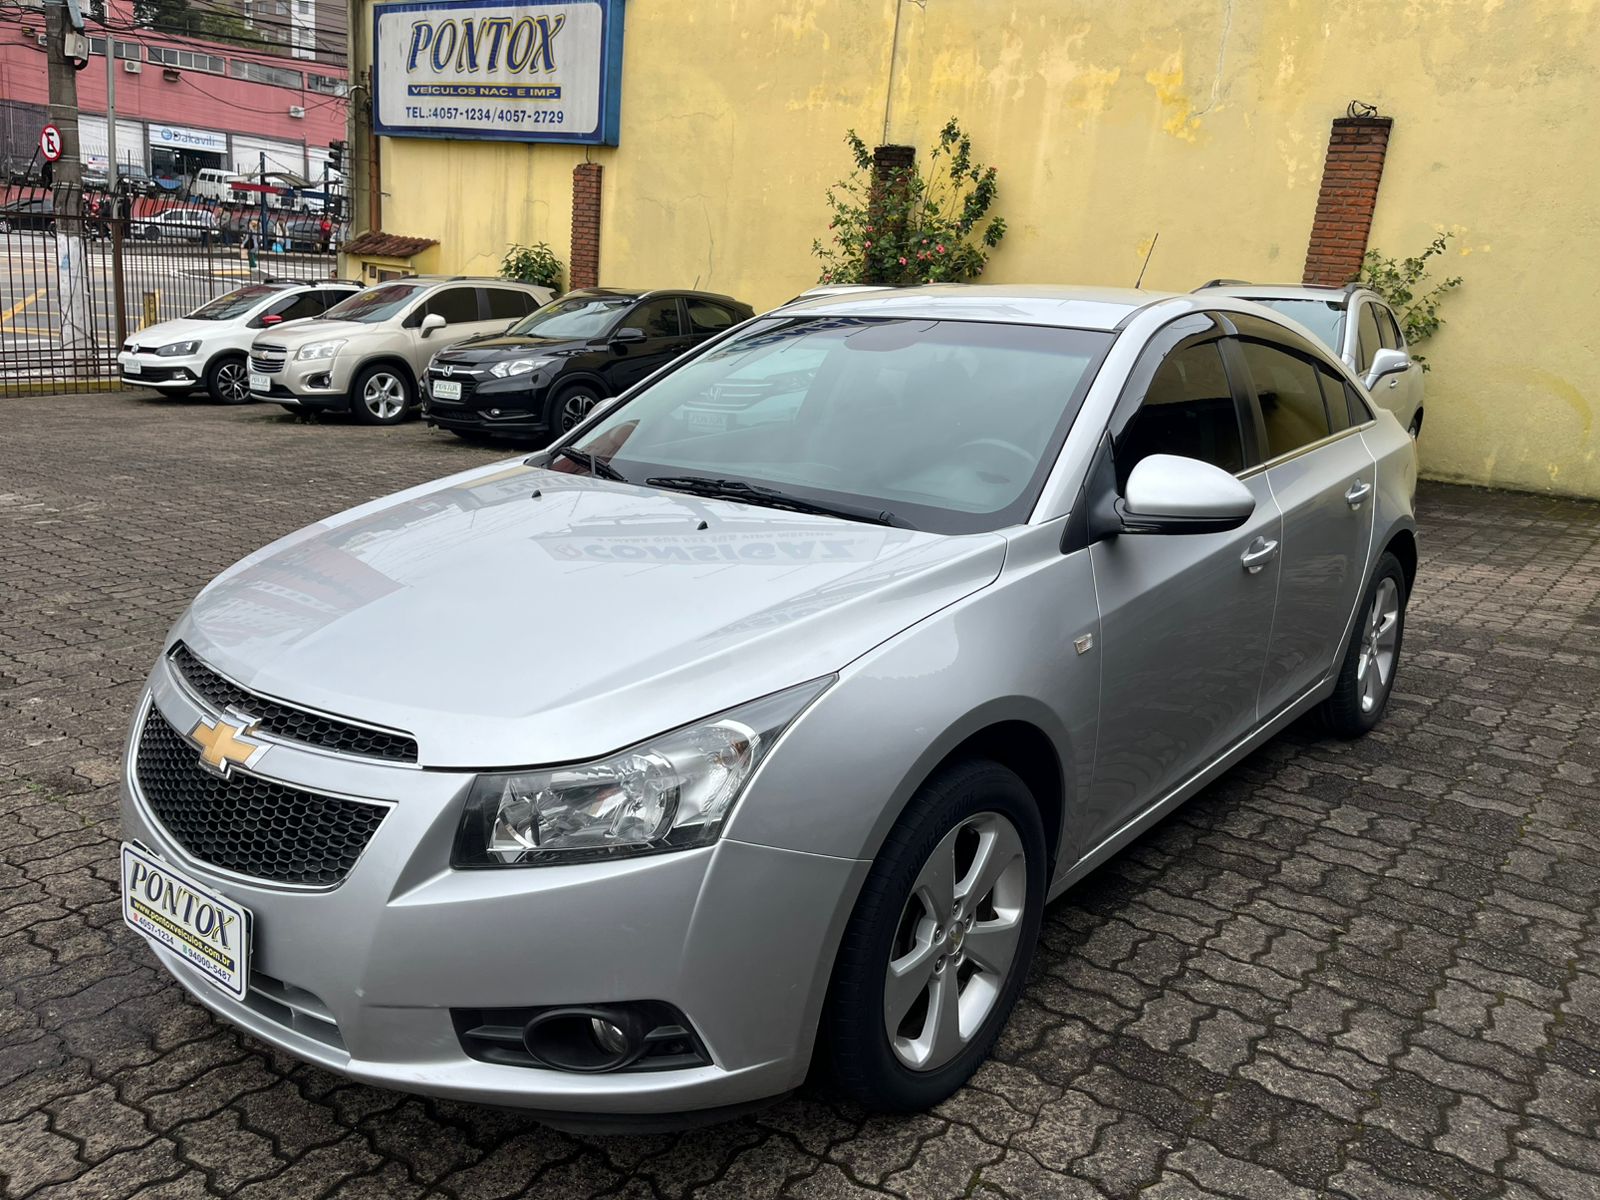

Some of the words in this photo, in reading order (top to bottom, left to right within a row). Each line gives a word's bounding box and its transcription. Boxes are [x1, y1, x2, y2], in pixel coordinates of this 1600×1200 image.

[406, 14, 566, 74] PONTOX
[411, 86, 477, 95] VEÍCULOS
[479, 87, 513, 96] NAC.
[530, 88, 558, 97] IMP.
[129, 859, 235, 951] PONTOX
[134, 901, 232, 967] www.pontoxveiculos.com.br
[138, 917, 175, 945] 4057-1234
[188, 947, 232, 983] 94000-5487
